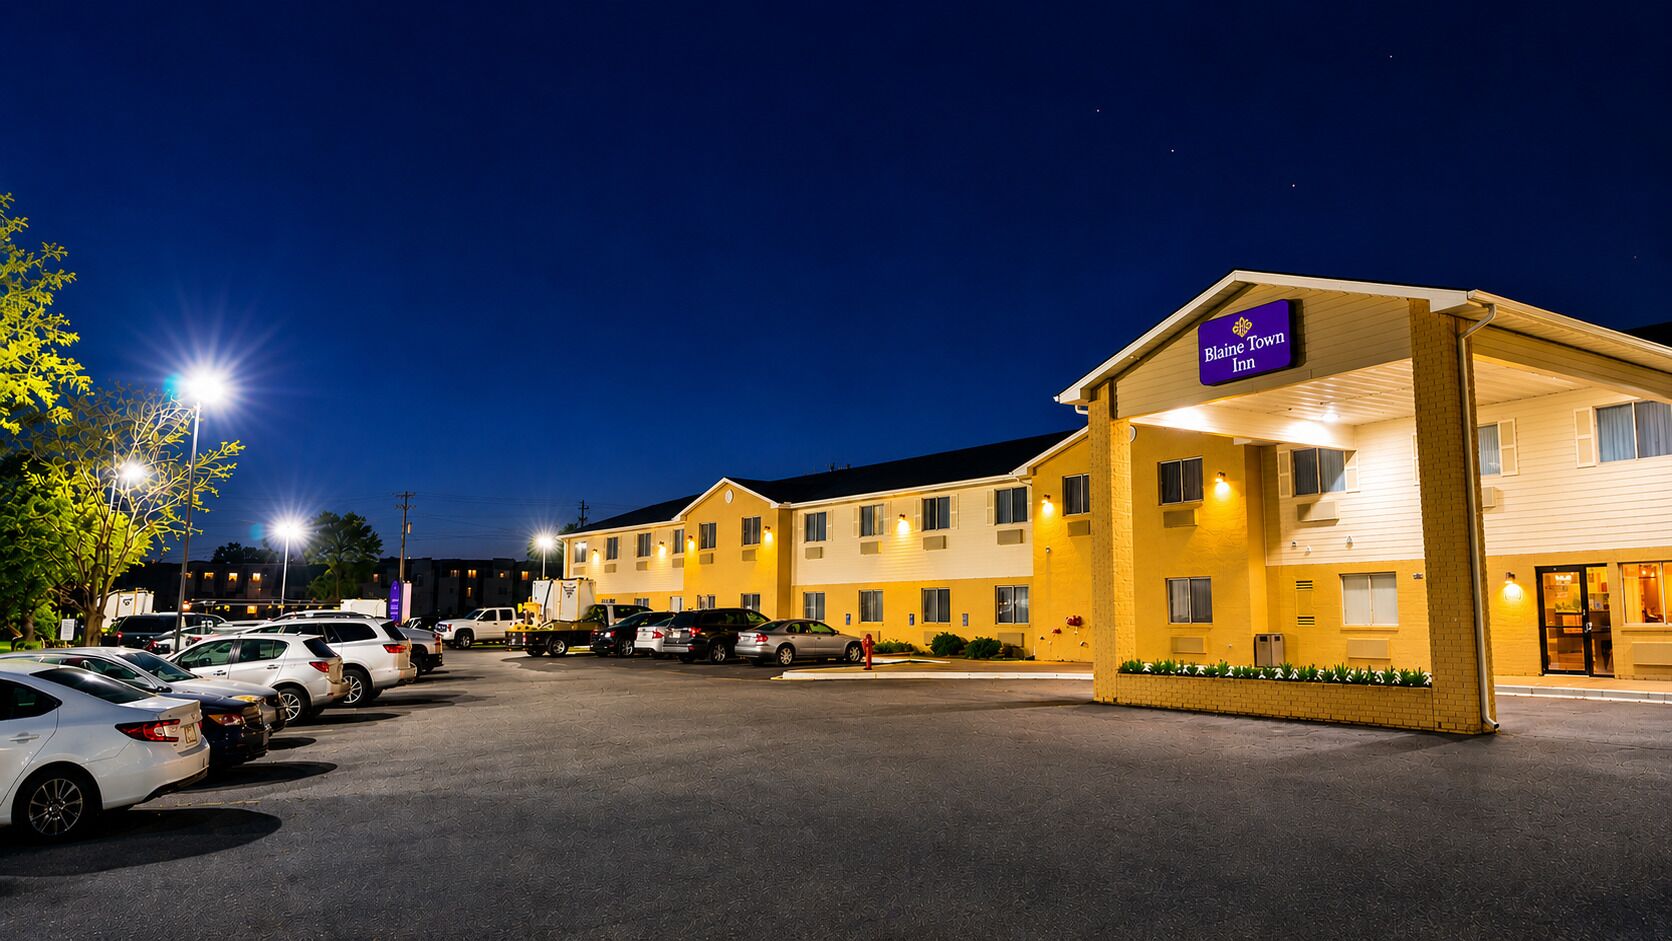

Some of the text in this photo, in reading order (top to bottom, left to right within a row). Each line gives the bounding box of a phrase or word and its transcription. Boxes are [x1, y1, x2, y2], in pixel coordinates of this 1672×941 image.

[1204, 332, 1285, 363] Blaine Town
[1232, 357, 1256, 373] Inn
